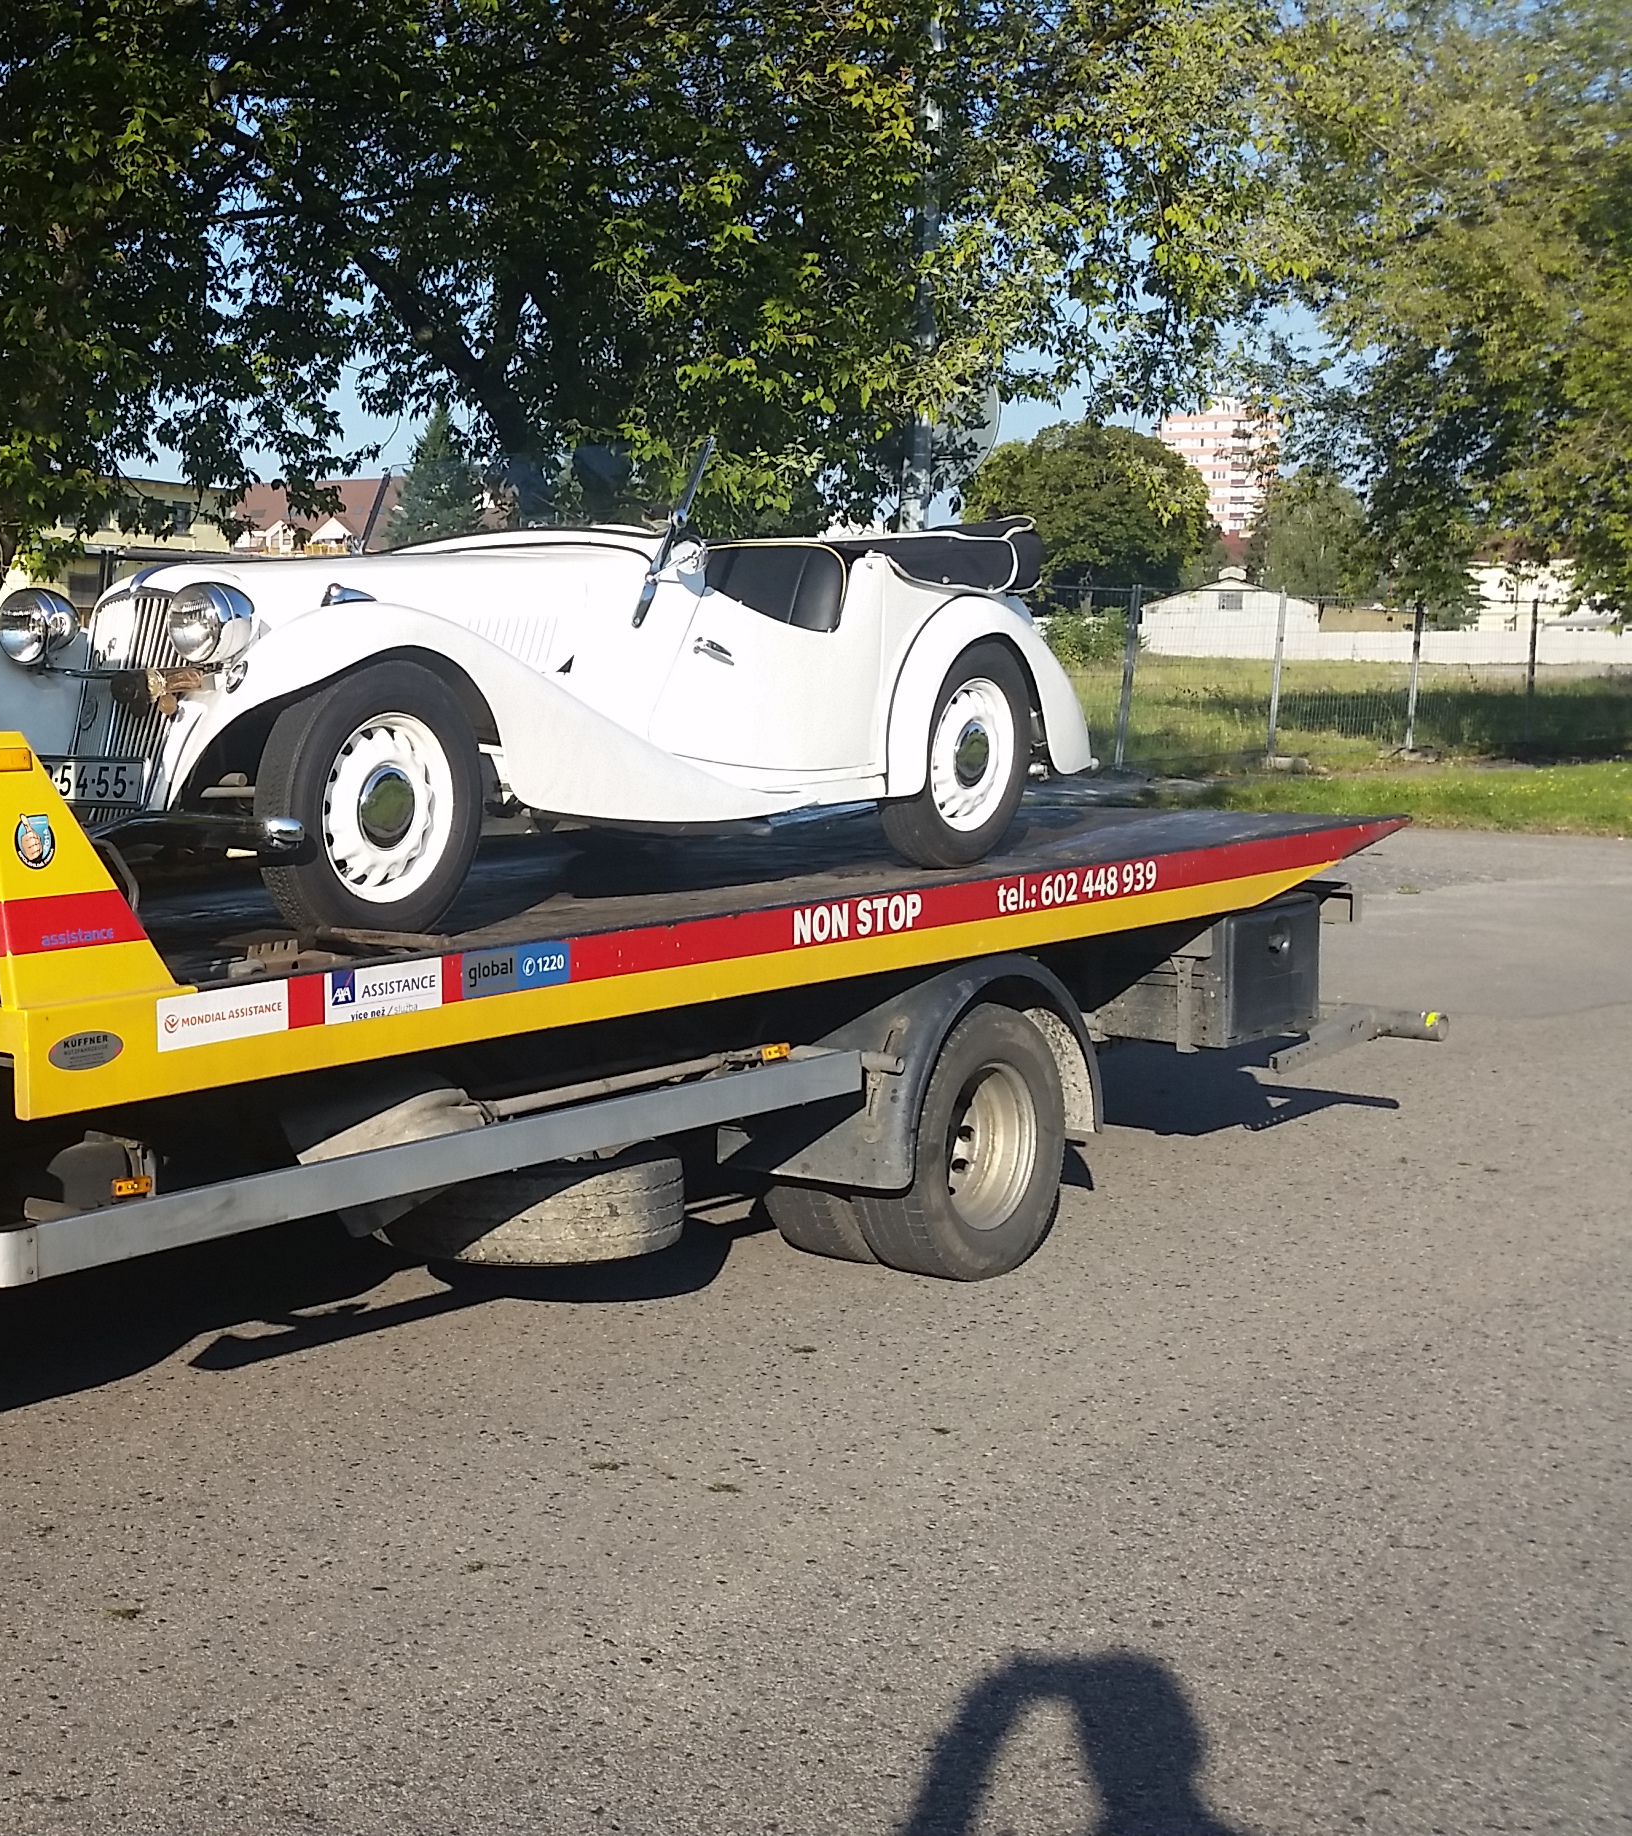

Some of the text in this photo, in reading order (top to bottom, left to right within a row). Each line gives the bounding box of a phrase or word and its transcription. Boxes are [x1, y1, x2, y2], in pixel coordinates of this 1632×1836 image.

[997, 860, 1158, 913] tel.: 602 448 939
[793, 892, 922, 946] NON STOP
[41, 927, 114, 947] assistance
[468, 953, 565, 988] global 1220
[332, 986, 353, 1005] AXA
[361, 974, 437, 999] ASSISTANCE
[181, 1001, 283, 1028] MONDIAL ASSISTANCE
